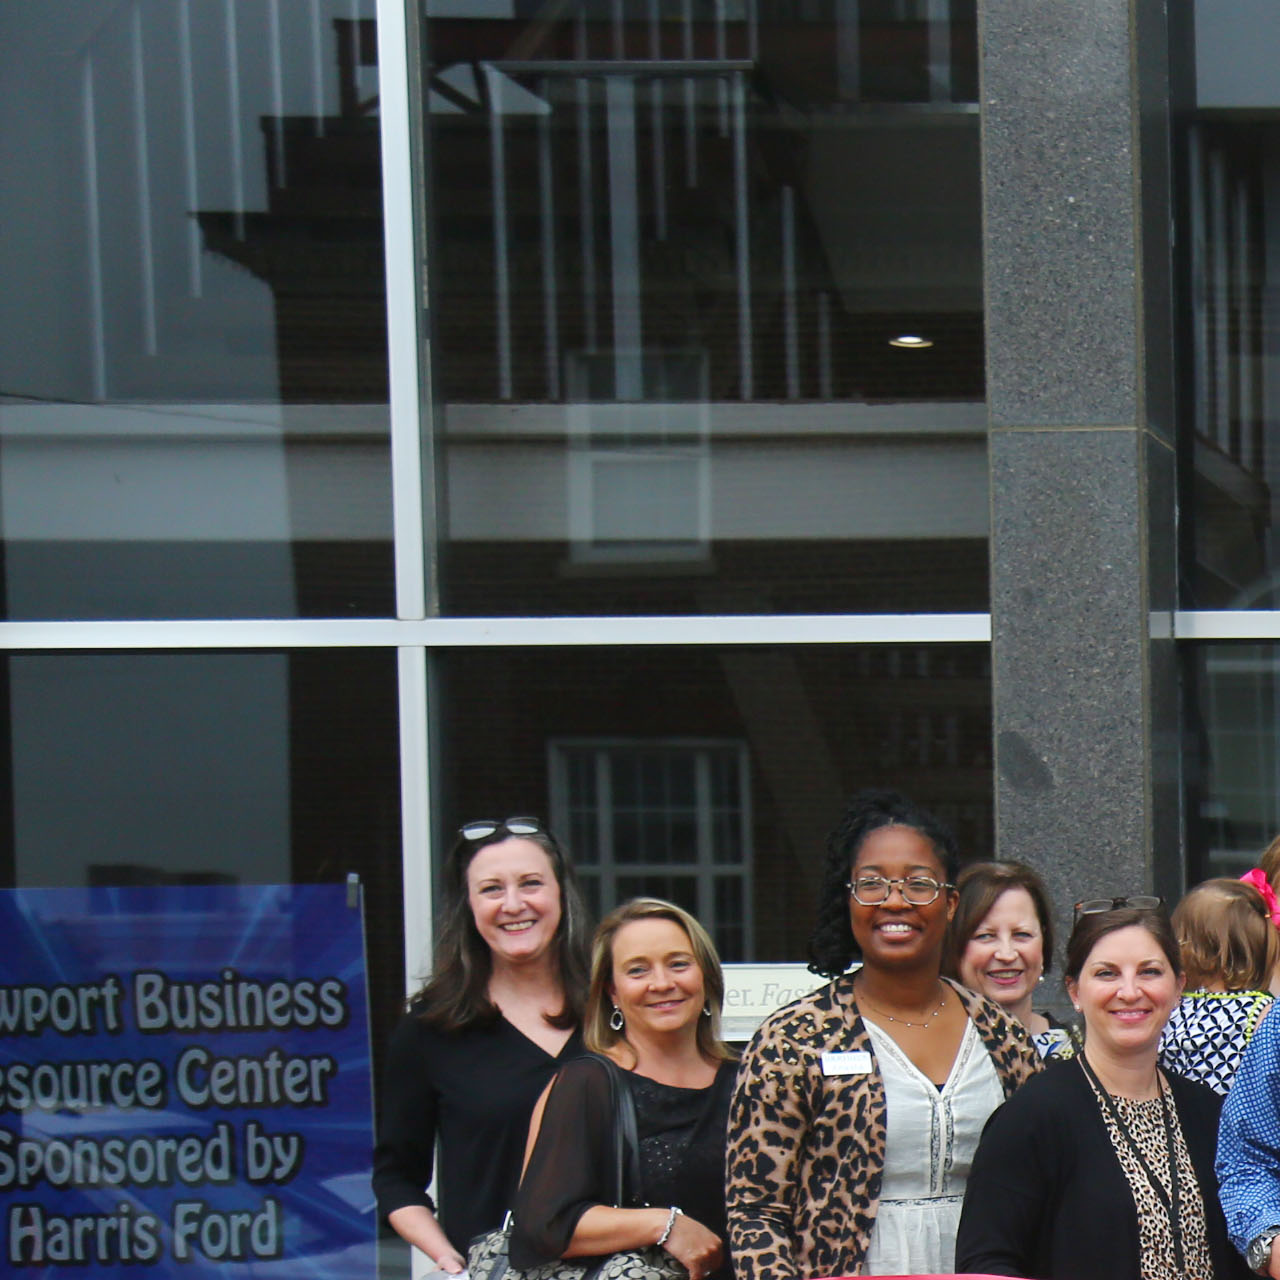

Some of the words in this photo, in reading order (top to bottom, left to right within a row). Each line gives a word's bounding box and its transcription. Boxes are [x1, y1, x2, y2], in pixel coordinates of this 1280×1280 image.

[135, 971, 346, 1030] Business
[0, 1061, 162, 1109] source
[177, 1048, 332, 1107] Center
[0, 1124, 231, 1186] Sponsored
[247, 1124, 299, 1180] by
[9, 1203, 158, 1263] Harris
[174, 1199, 278, 1261] Ford
